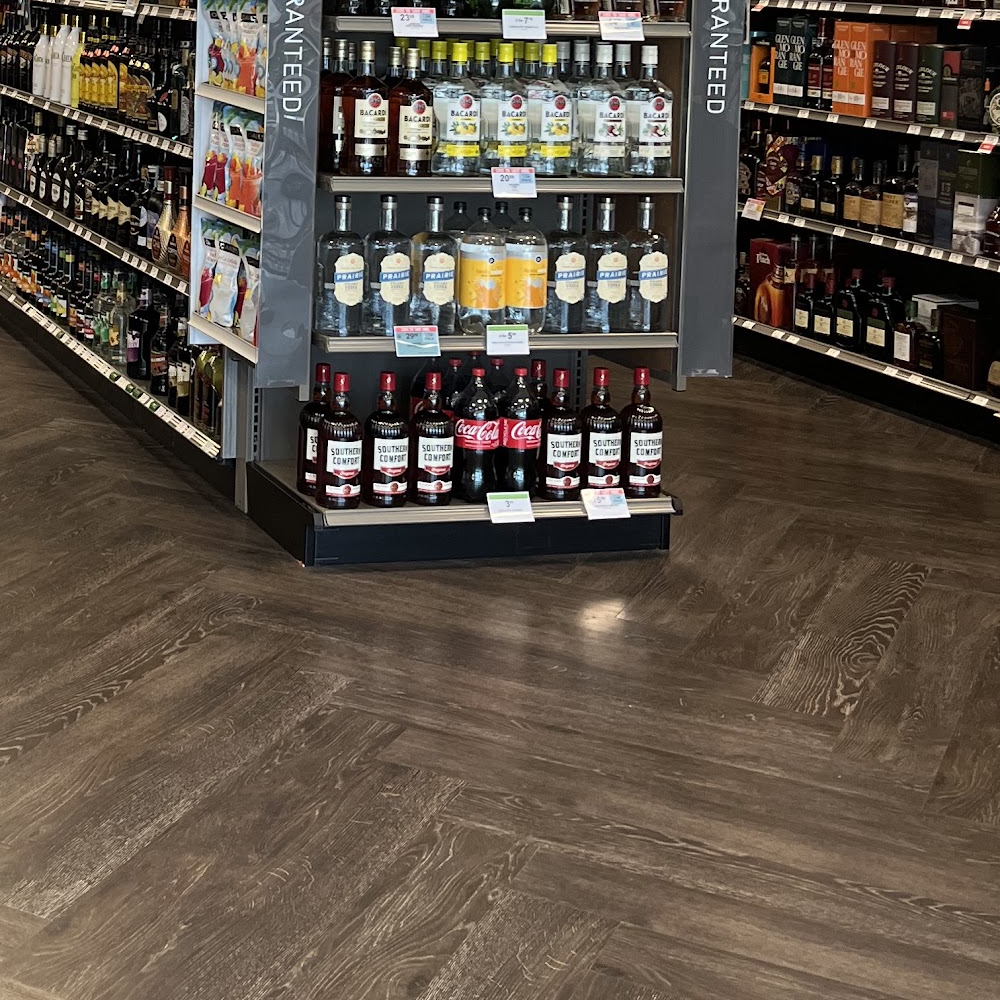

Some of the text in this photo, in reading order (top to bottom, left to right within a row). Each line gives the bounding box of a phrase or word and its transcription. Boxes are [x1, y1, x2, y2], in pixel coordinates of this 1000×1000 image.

[450, 109, 478, 117] BACARDI
[404, 115, 431, 123] BACARDI
[552, 449, 579, 458] COMFORT
[595, 448, 620, 456] COMFORT
[636, 447, 662, 456] COMFORT
[332, 456, 360, 465] COMFORT
[379, 454, 407, 463] COMFORT
[423, 453, 451, 461] COMFORT
